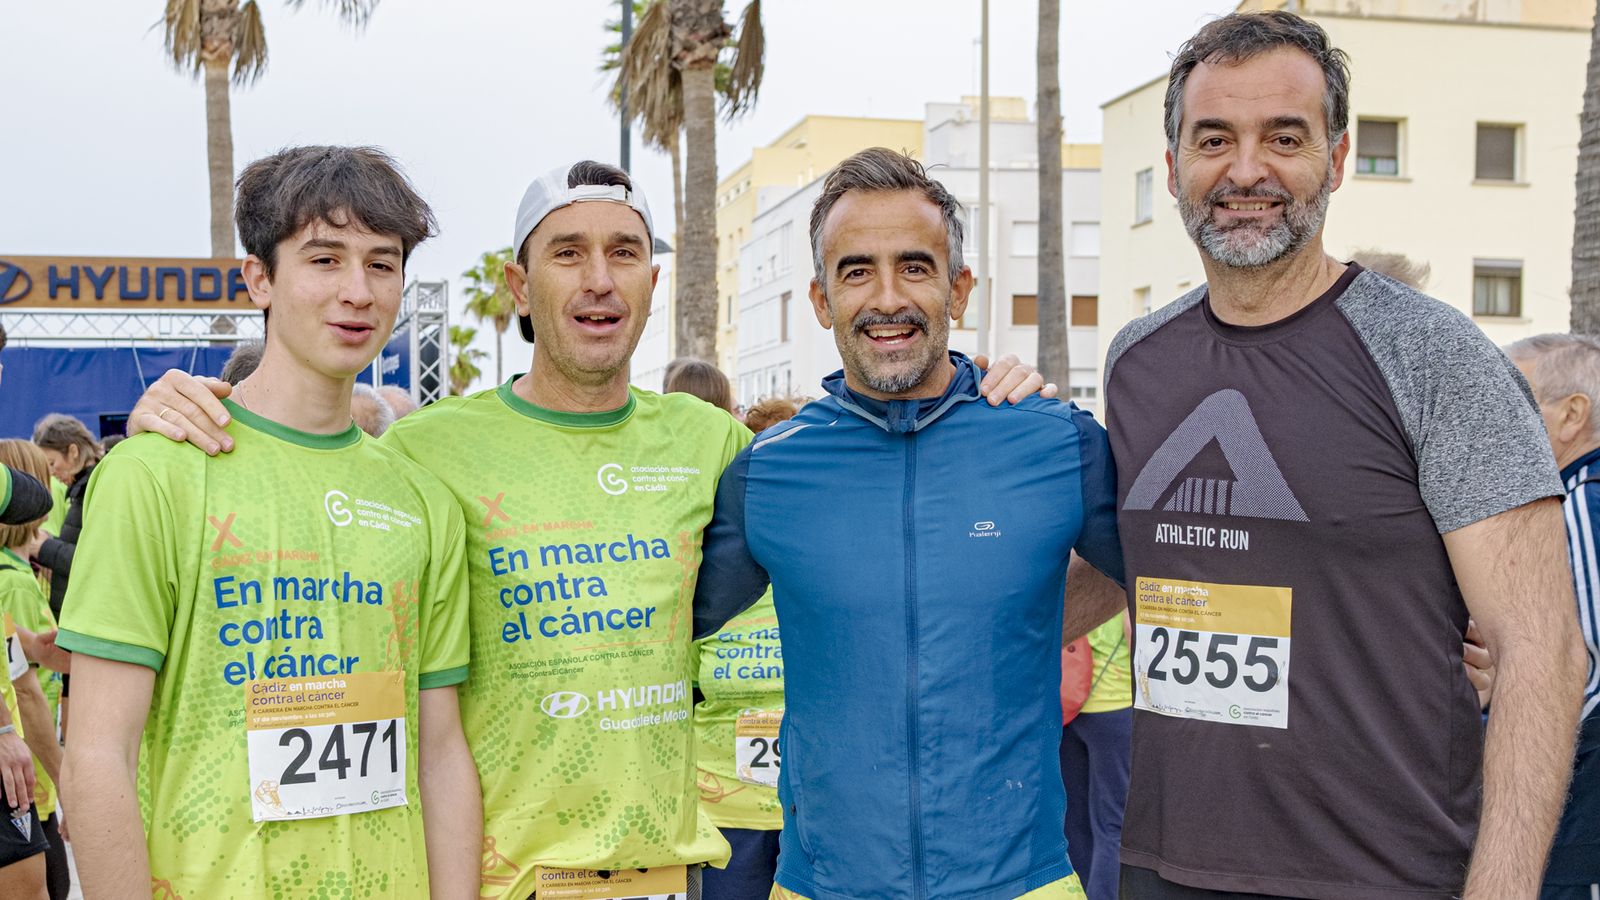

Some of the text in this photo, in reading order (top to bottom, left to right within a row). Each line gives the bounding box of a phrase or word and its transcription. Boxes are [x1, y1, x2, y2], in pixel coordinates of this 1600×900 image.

[48, 264, 248, 301] HYUNDA
[1155, 523, 1249, 551] ATHLETIC RUN
[488, 534, 670, 576] En marcha
[213, 571, 383, 609] En marcha
[500, 573, 608, 609] contra
[1140, 594, 1164, 604] contra
[1166, 595, 1173, 604] el
[1162, 585, 1173, 593] en
[218, 609, 324, 647] contra
[502, 606, 656, 643] el cáncer
[224, 652, 256, 686] el
[713, 662, 784, 679] el cán
[1148, 627, 1278, 693] 2555
[252, 678, 347, 695] Cádiz en marcha
[252, 691, 345, 706] contra el cáncer
[597, 680, 686, 711] HYUNDAI
[279, 719, 398, 785] 2471
[541, 870, 575, 880] contra
[578, 868, 586, 878] el
